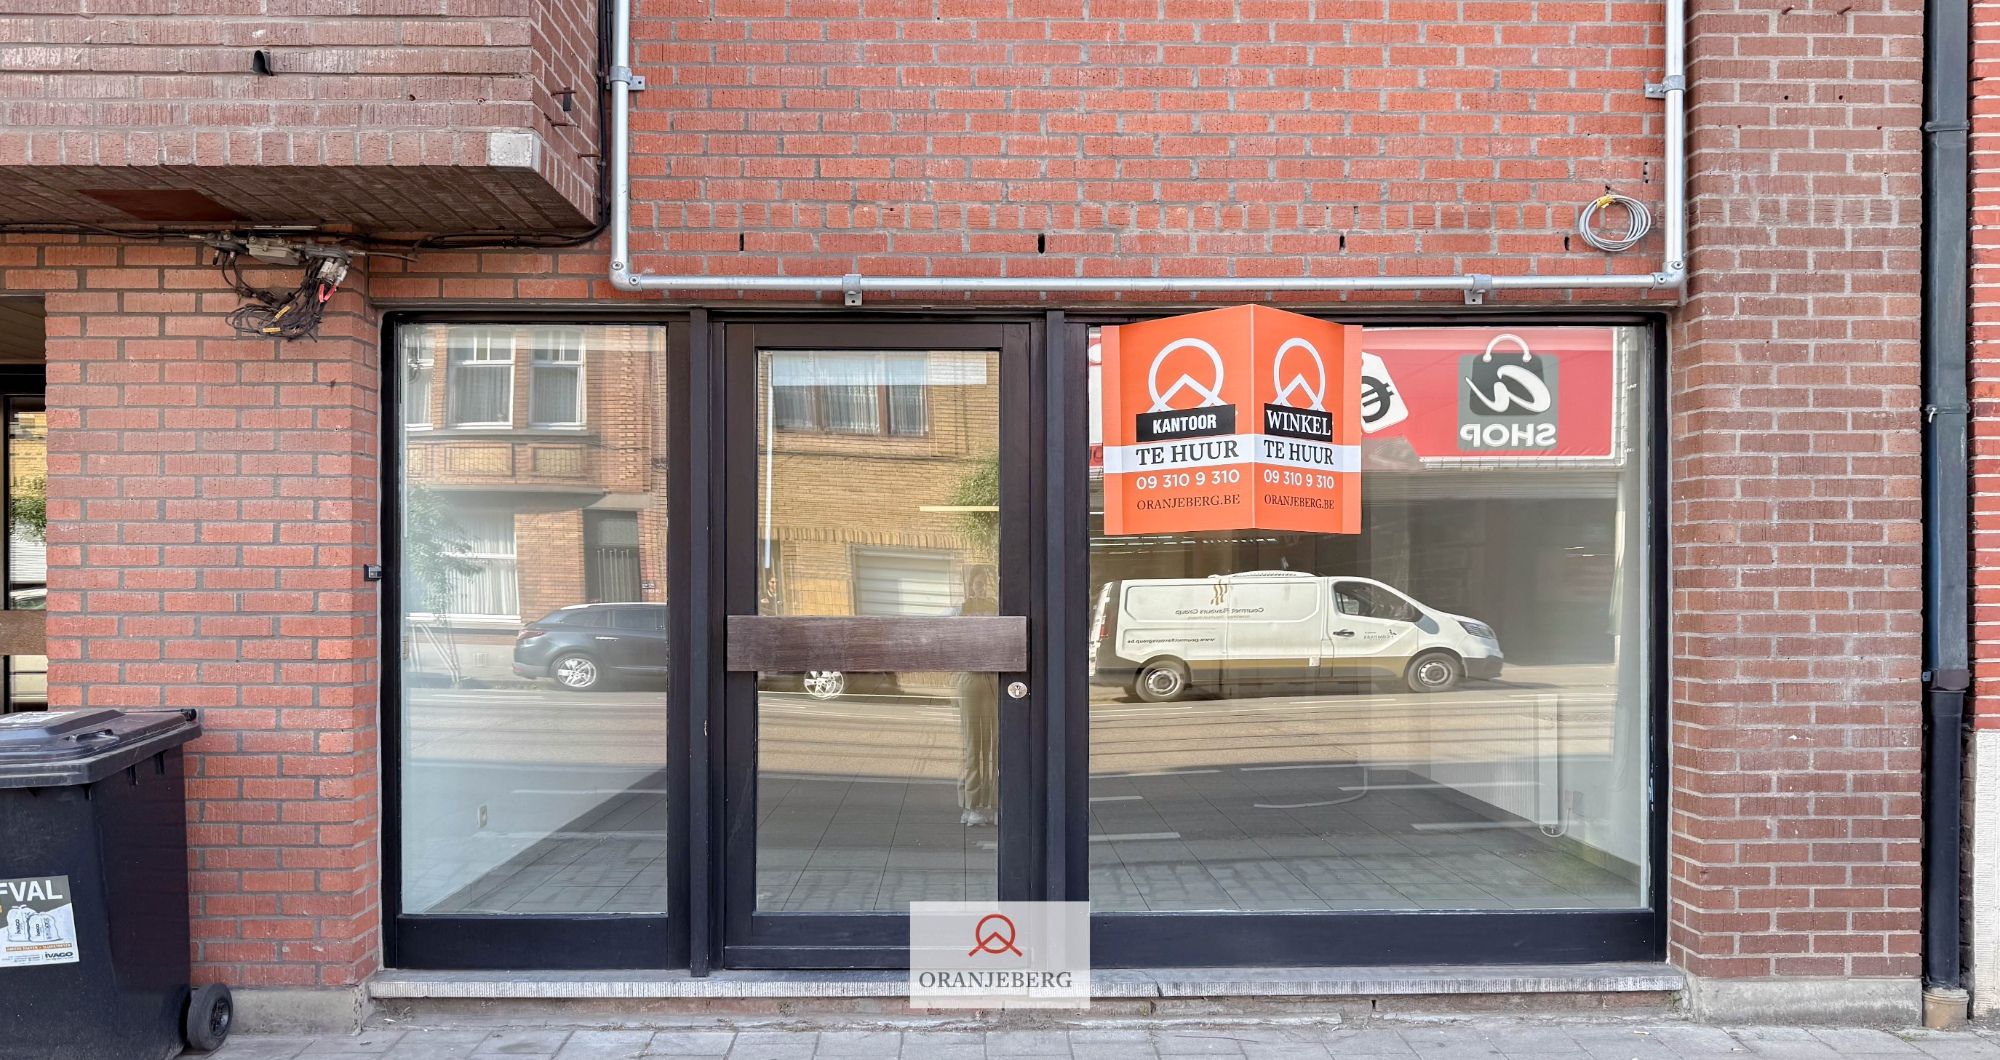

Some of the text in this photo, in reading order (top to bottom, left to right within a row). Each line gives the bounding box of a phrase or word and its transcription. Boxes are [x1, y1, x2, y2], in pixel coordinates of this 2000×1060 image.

[1153, 414, 1217, 434] KANTOOR
[1266, 410, 1331, 436] WINKEL
[1136, 440, 1239, 466] TE HUUR
[1264, 439, 1334, 465] TE HUUR
[1136, 469, 1240, 490] 09 310 9 310
[1264, 469, 1334, 489] 09 310 9 310
[1136, 494, 1240, 510] ORANJEBERG.BE
[1264, 494, 1335, 510] ORANJEBERG.BE
